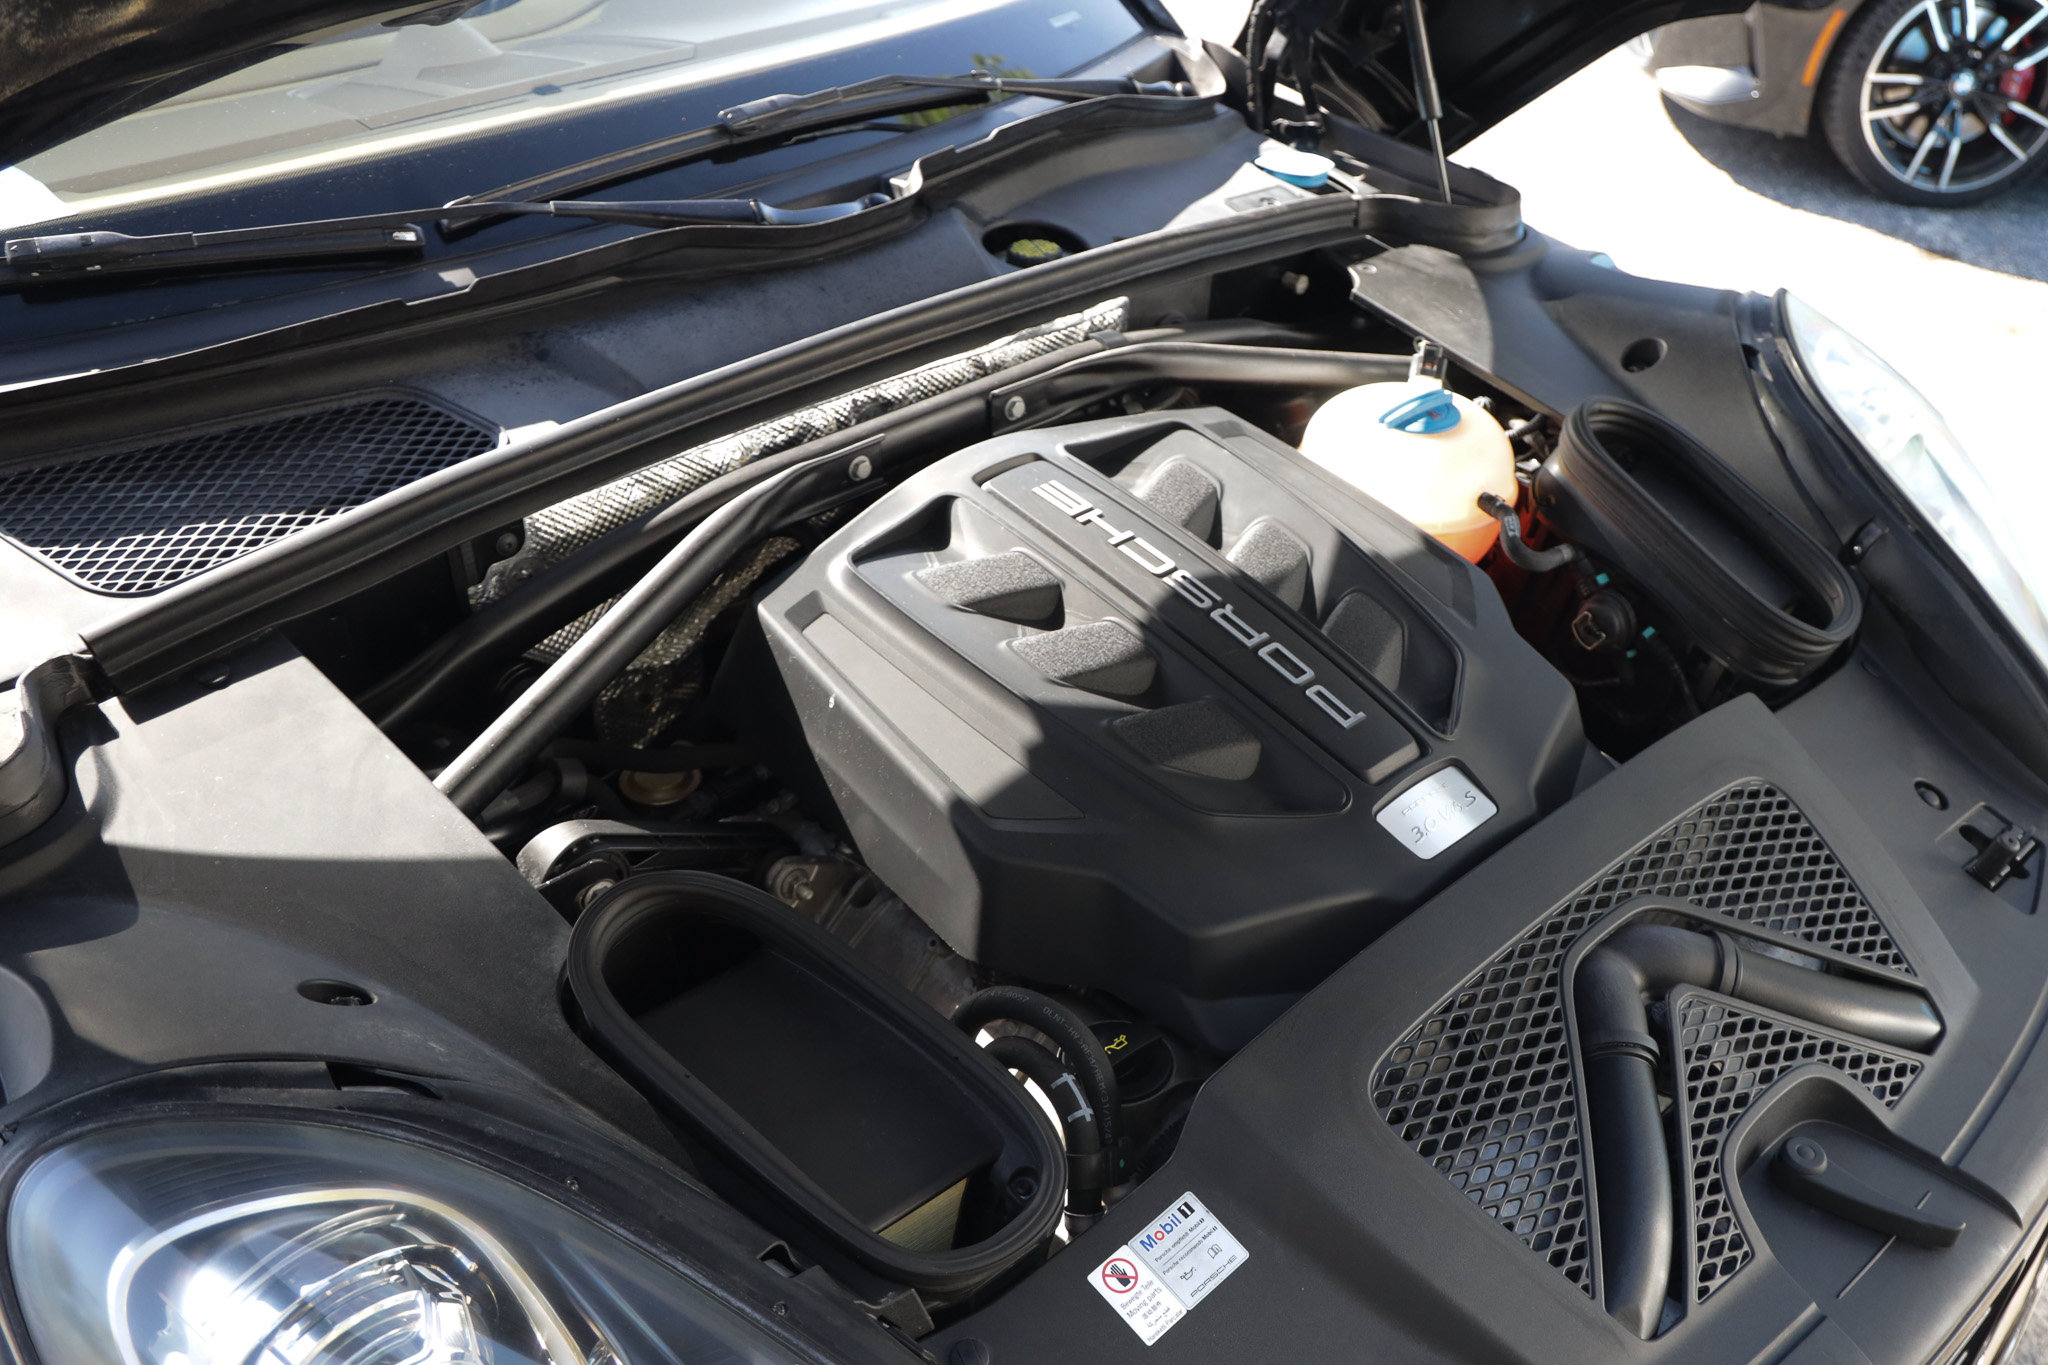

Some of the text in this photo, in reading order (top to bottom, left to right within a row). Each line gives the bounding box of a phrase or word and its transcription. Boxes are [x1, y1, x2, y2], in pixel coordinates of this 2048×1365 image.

[1031, 480, 1367, 729] PORSCHE
[1464, 790, 1476, 807] S
[1139, 1203, 1193, 1251] Mobil 1
[1191, 1255, 1237, 1297] PORSCHE
[1126, 1287, 1162, 1318] Moving parts
